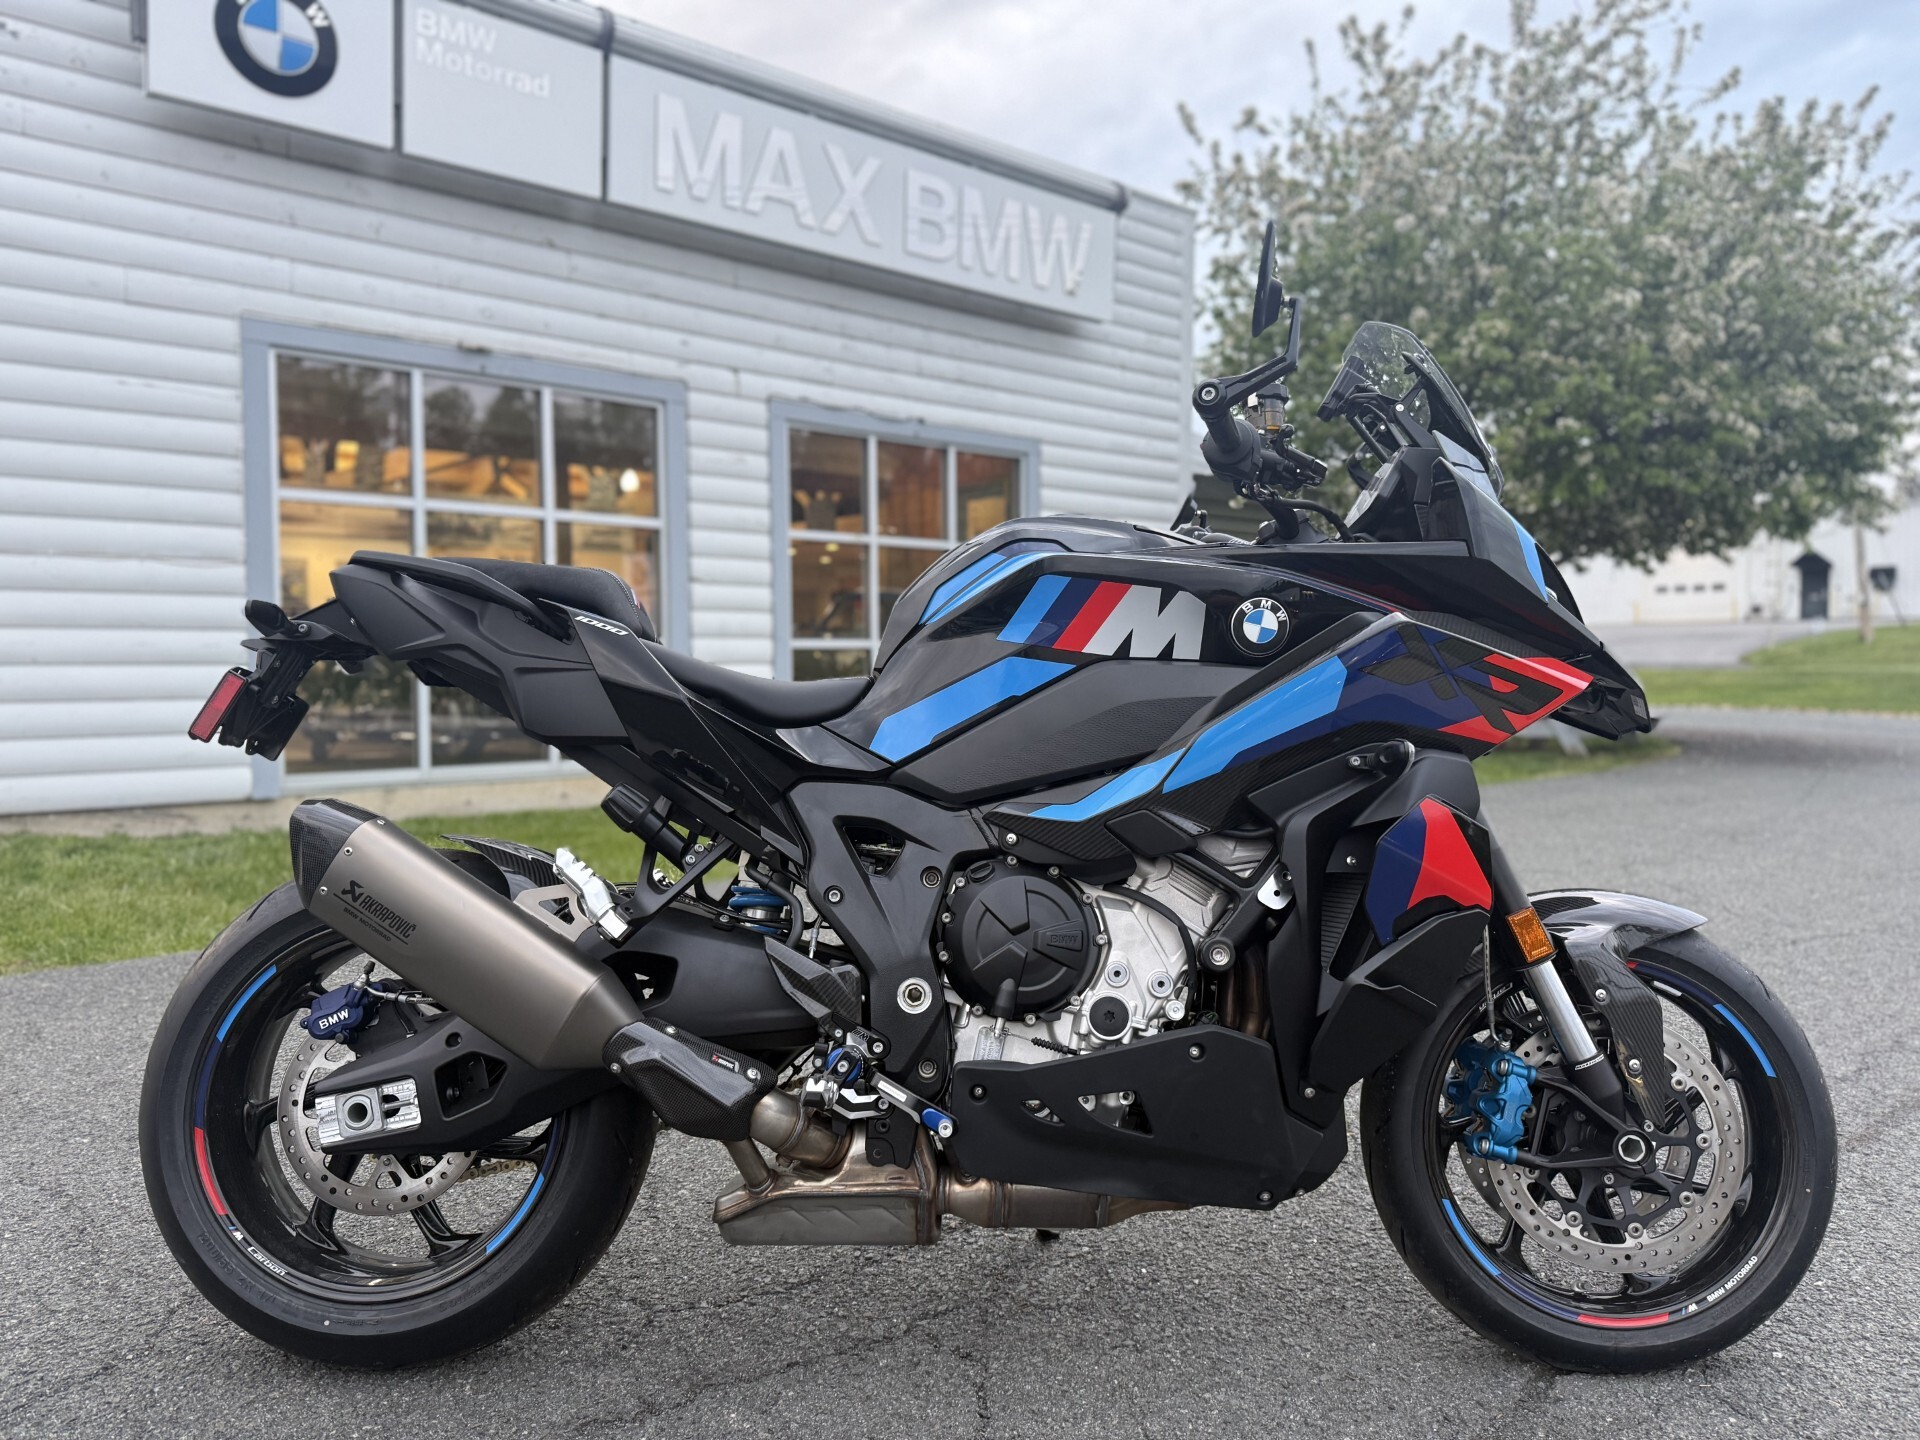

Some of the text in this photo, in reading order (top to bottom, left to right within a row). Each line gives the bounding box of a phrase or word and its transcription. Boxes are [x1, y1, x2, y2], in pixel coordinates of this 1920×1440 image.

[416, 7, 498, 54] BMW
[416, 36, 551, 99] Motorrad
[655, 92, 1094, 296] MAX BMW
[574, 615, 629, 636] 1000
[1241, 599, 1288, 622] BMW
[343, 906, 392, 942] BMW MOTORRAD
[358, 894, 417, 939] AKRAPOVIČ
[1050, 934, 1079, 945] BMW
[318, 1008, 349, 1030] BMW
[247, 1246, 288, 1276] Carbon
[1706, 1286, 1726, 1302] BMW
[1724, 1255, 1758, 1290] MOTORRAD
